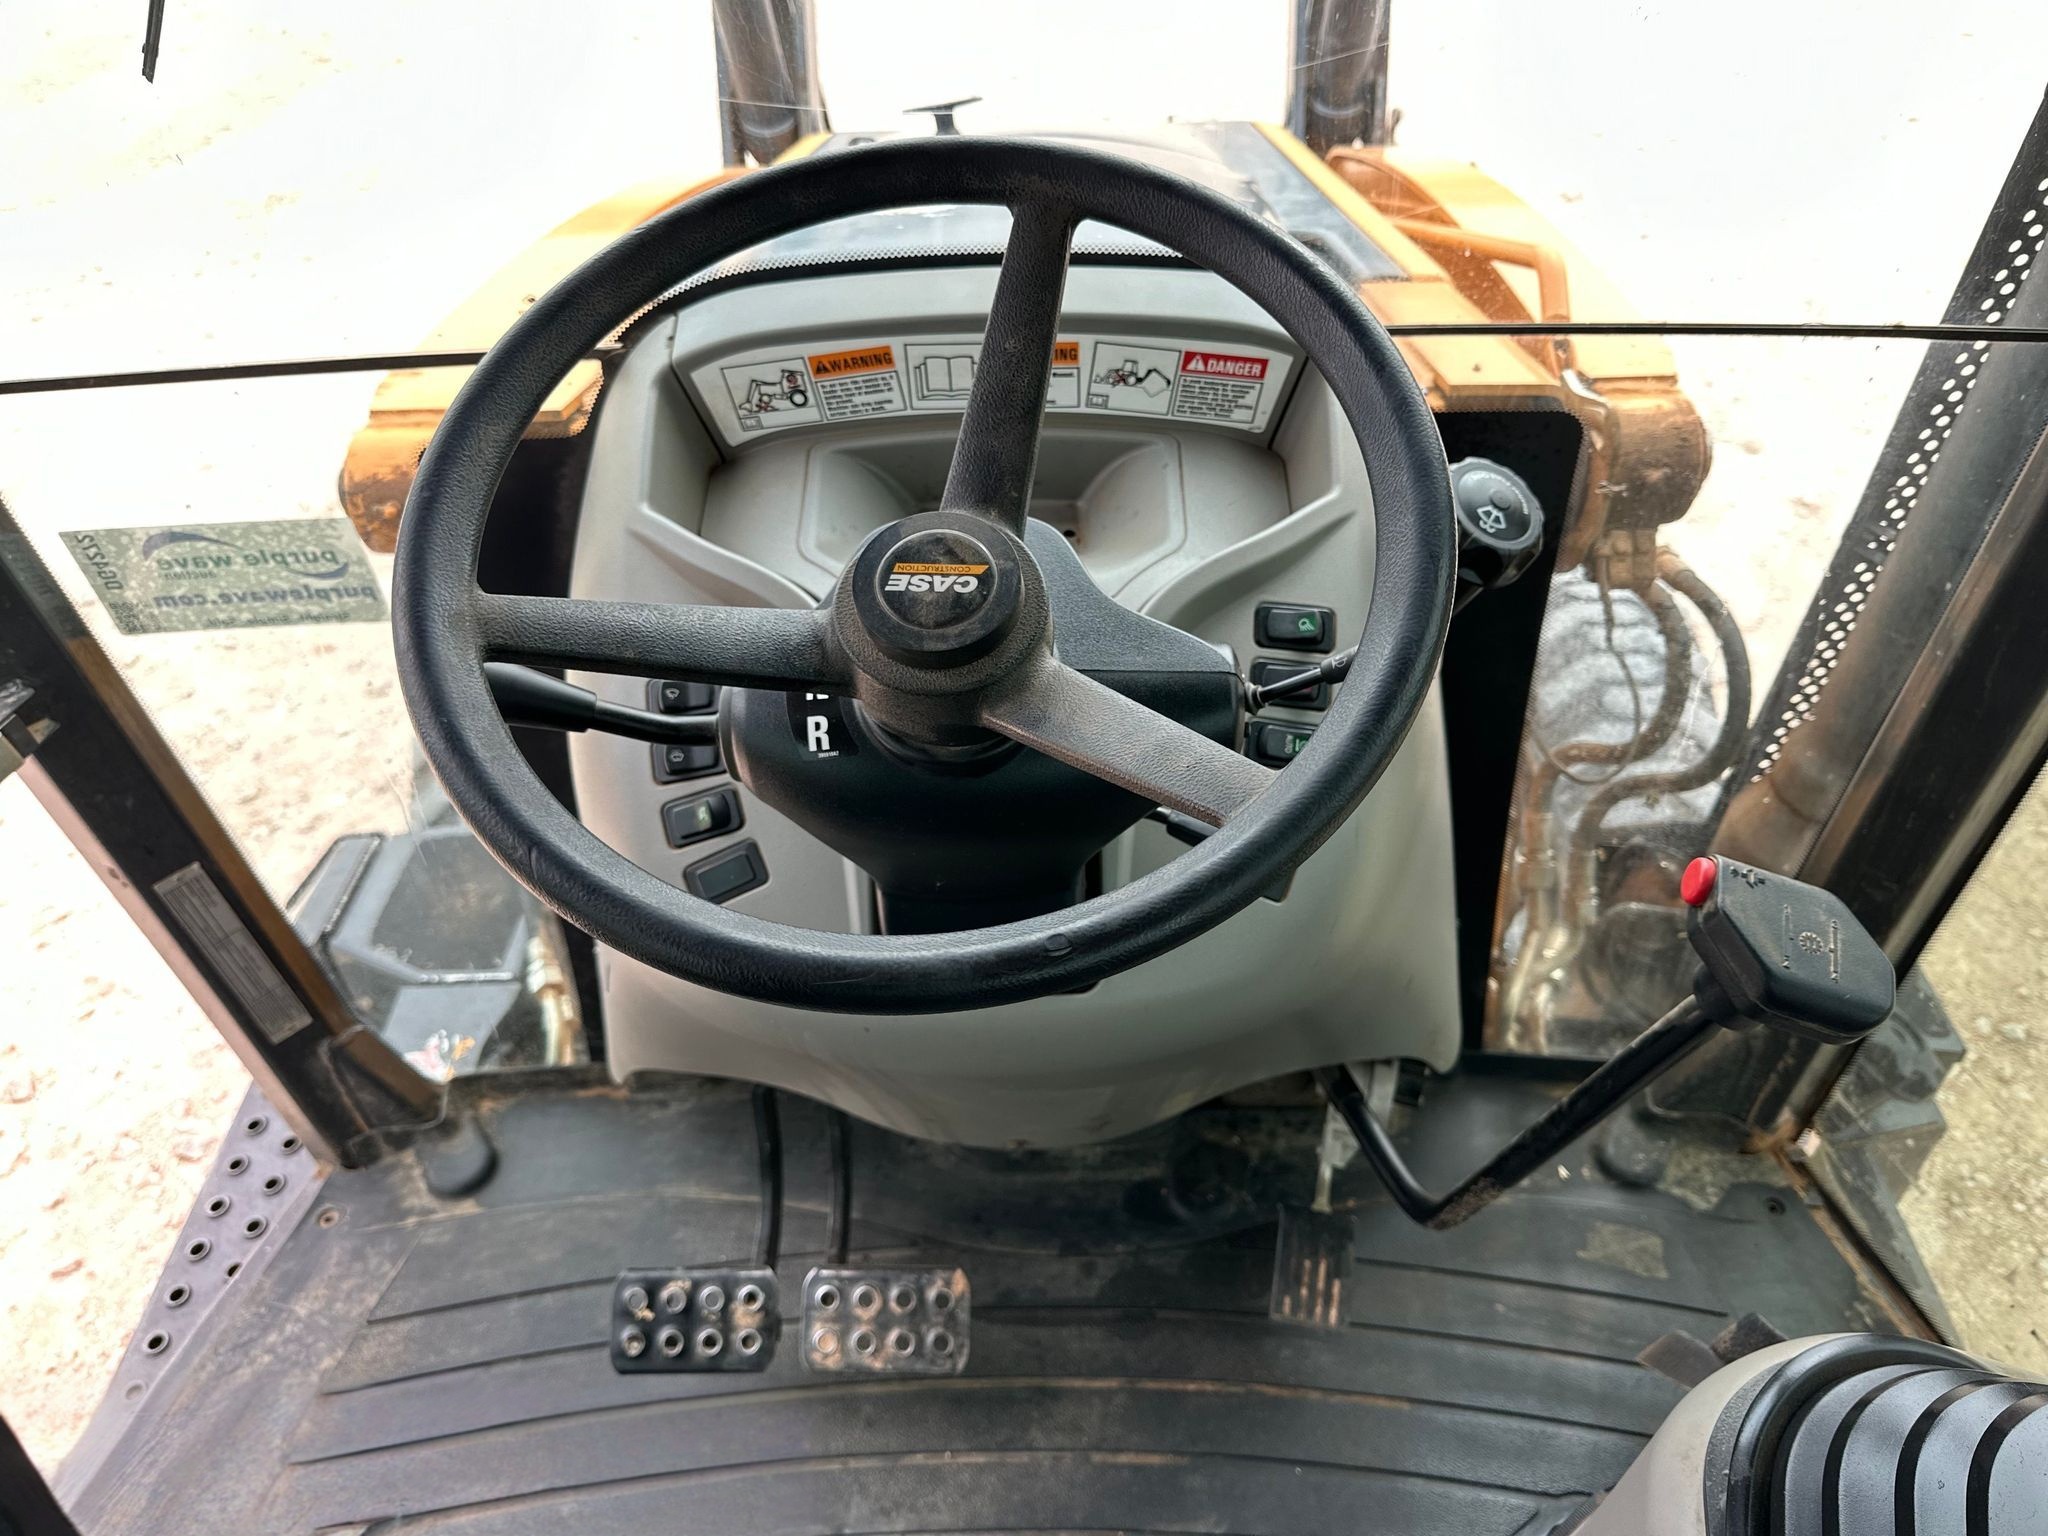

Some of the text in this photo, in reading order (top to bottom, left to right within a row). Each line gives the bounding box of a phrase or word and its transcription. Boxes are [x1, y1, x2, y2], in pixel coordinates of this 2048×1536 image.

[828, 351, 893, 373] WARNING
[1206, 357, 1263, 378] DANGER
[897, 564, 971, 573] CONSTRUCTION
[884, 574, 979, 593] CASE
[806, 714, 831, 752] R
